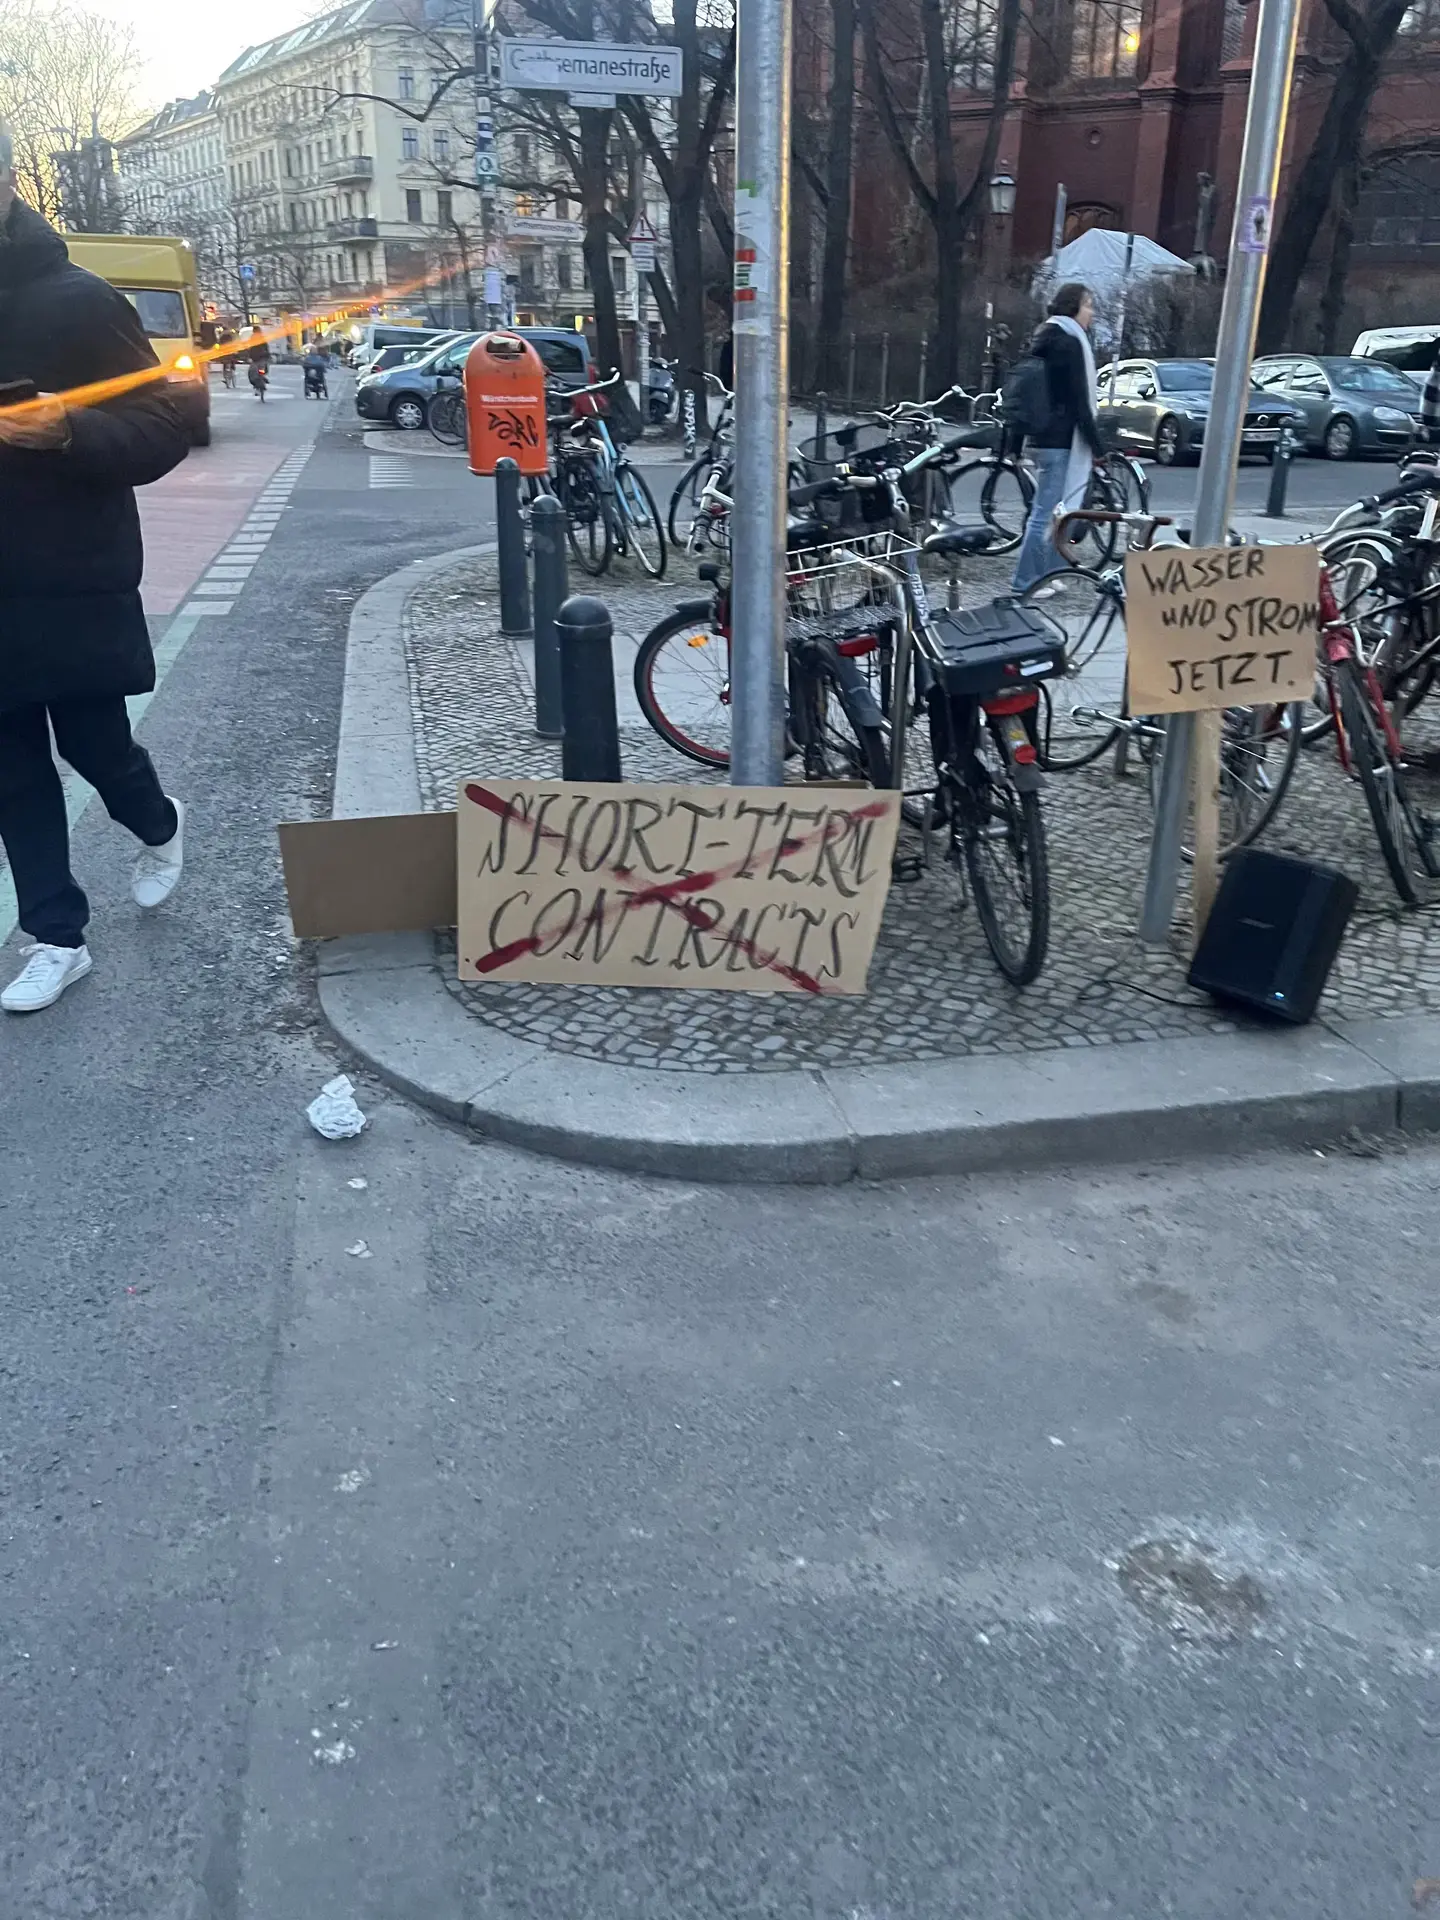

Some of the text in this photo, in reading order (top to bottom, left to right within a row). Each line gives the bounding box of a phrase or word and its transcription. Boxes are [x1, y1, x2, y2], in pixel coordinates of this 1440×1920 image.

[510, 48, 670, 83] Gemanestraße
[1141, 549, 1265, 596] WASSER
[1217, 597, 1320, 642] STROM
[1168, 650, 1295, 695] JETZT.
[477, 792, 879, 898] SHORT-TERM
[488, 887, 860, 979] CONTRACTS
